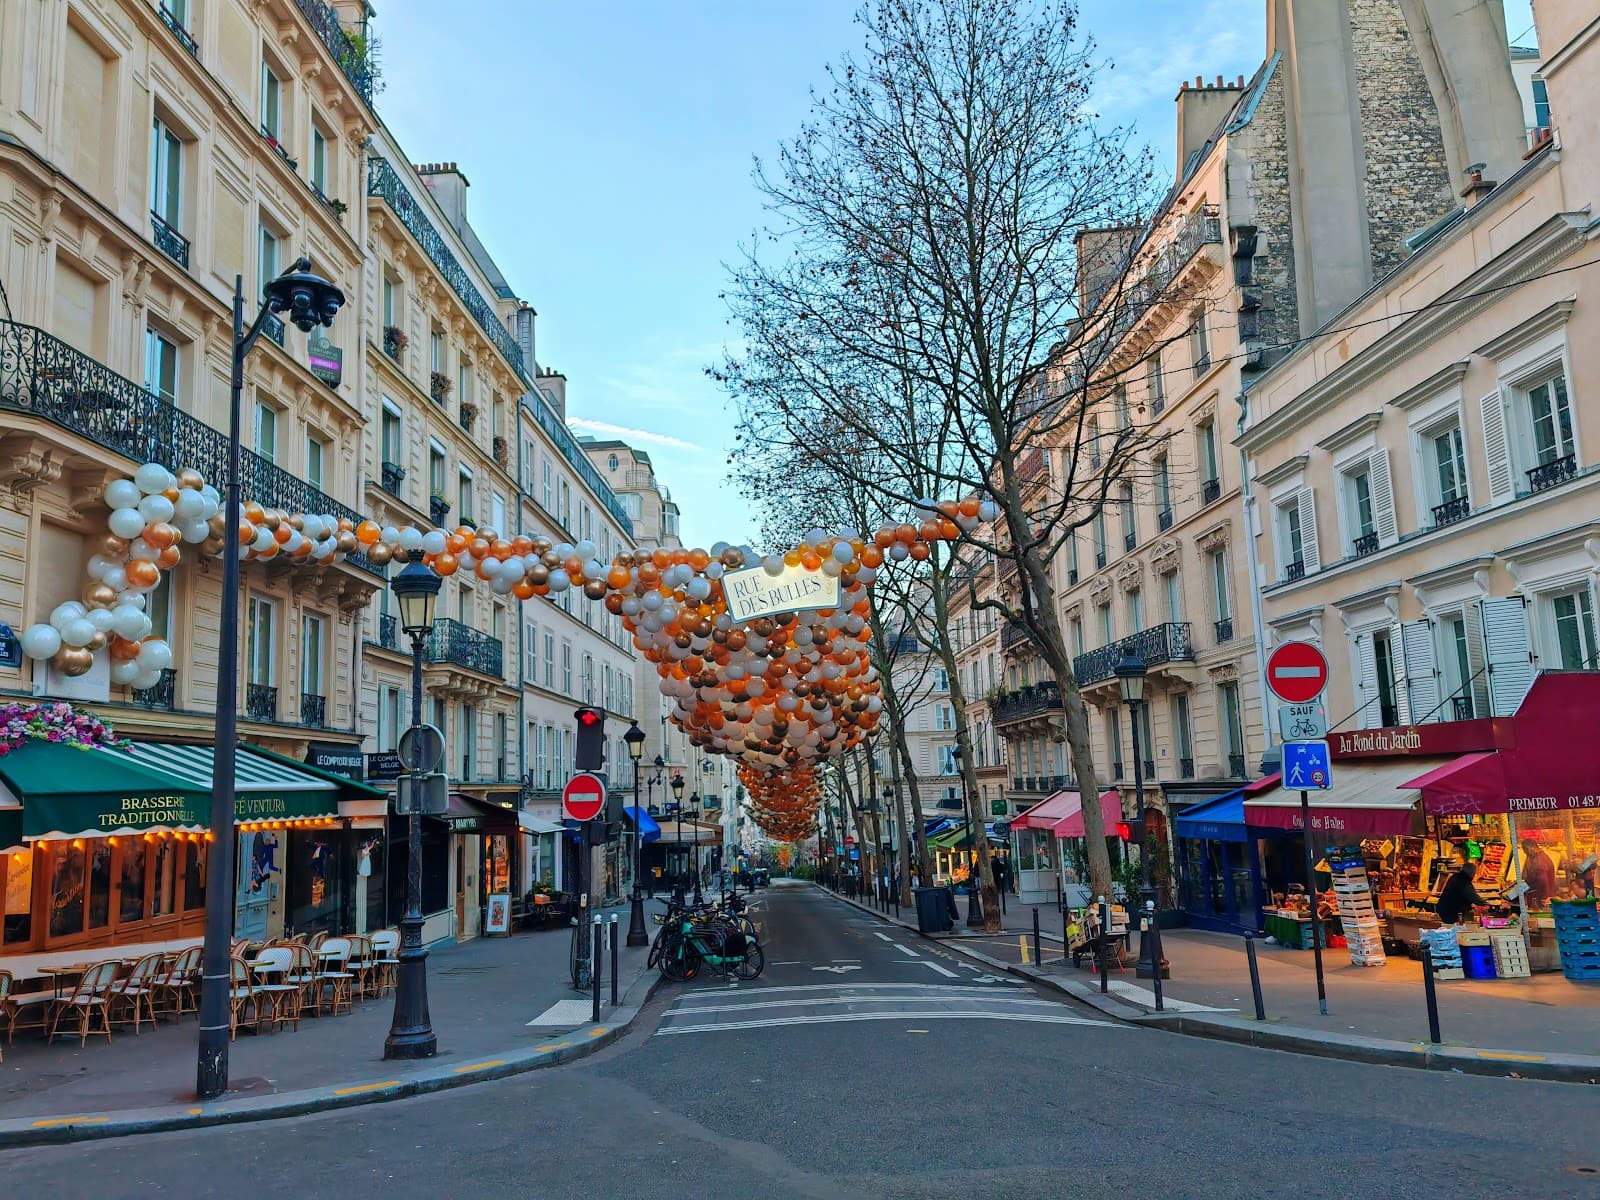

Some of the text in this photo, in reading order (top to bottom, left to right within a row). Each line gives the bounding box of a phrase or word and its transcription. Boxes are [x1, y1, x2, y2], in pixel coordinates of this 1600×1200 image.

[733, 574, 760, 598] RUE
[739, 575, 822, 616] DES BULLES
[1290, 706, 1314, 716] SAUF
[1339, 735, 1352, 753] Au
[1376, 732, 1388, 751] du
[1390, 730, 1422, 750] Jardin
[317, 755, 323, 765] LE
[121, 796, 185, 810] BRASSERIE
[234, 796, 286, 814] FÉ VENTURA
[1508, 797, 1558, 811] PRIMEUR
[1568, 796, 1580, 808] 01
[1582, 794, 1595, 807] 48
[98, 810, 195, 826] TRADITIONNELLE
